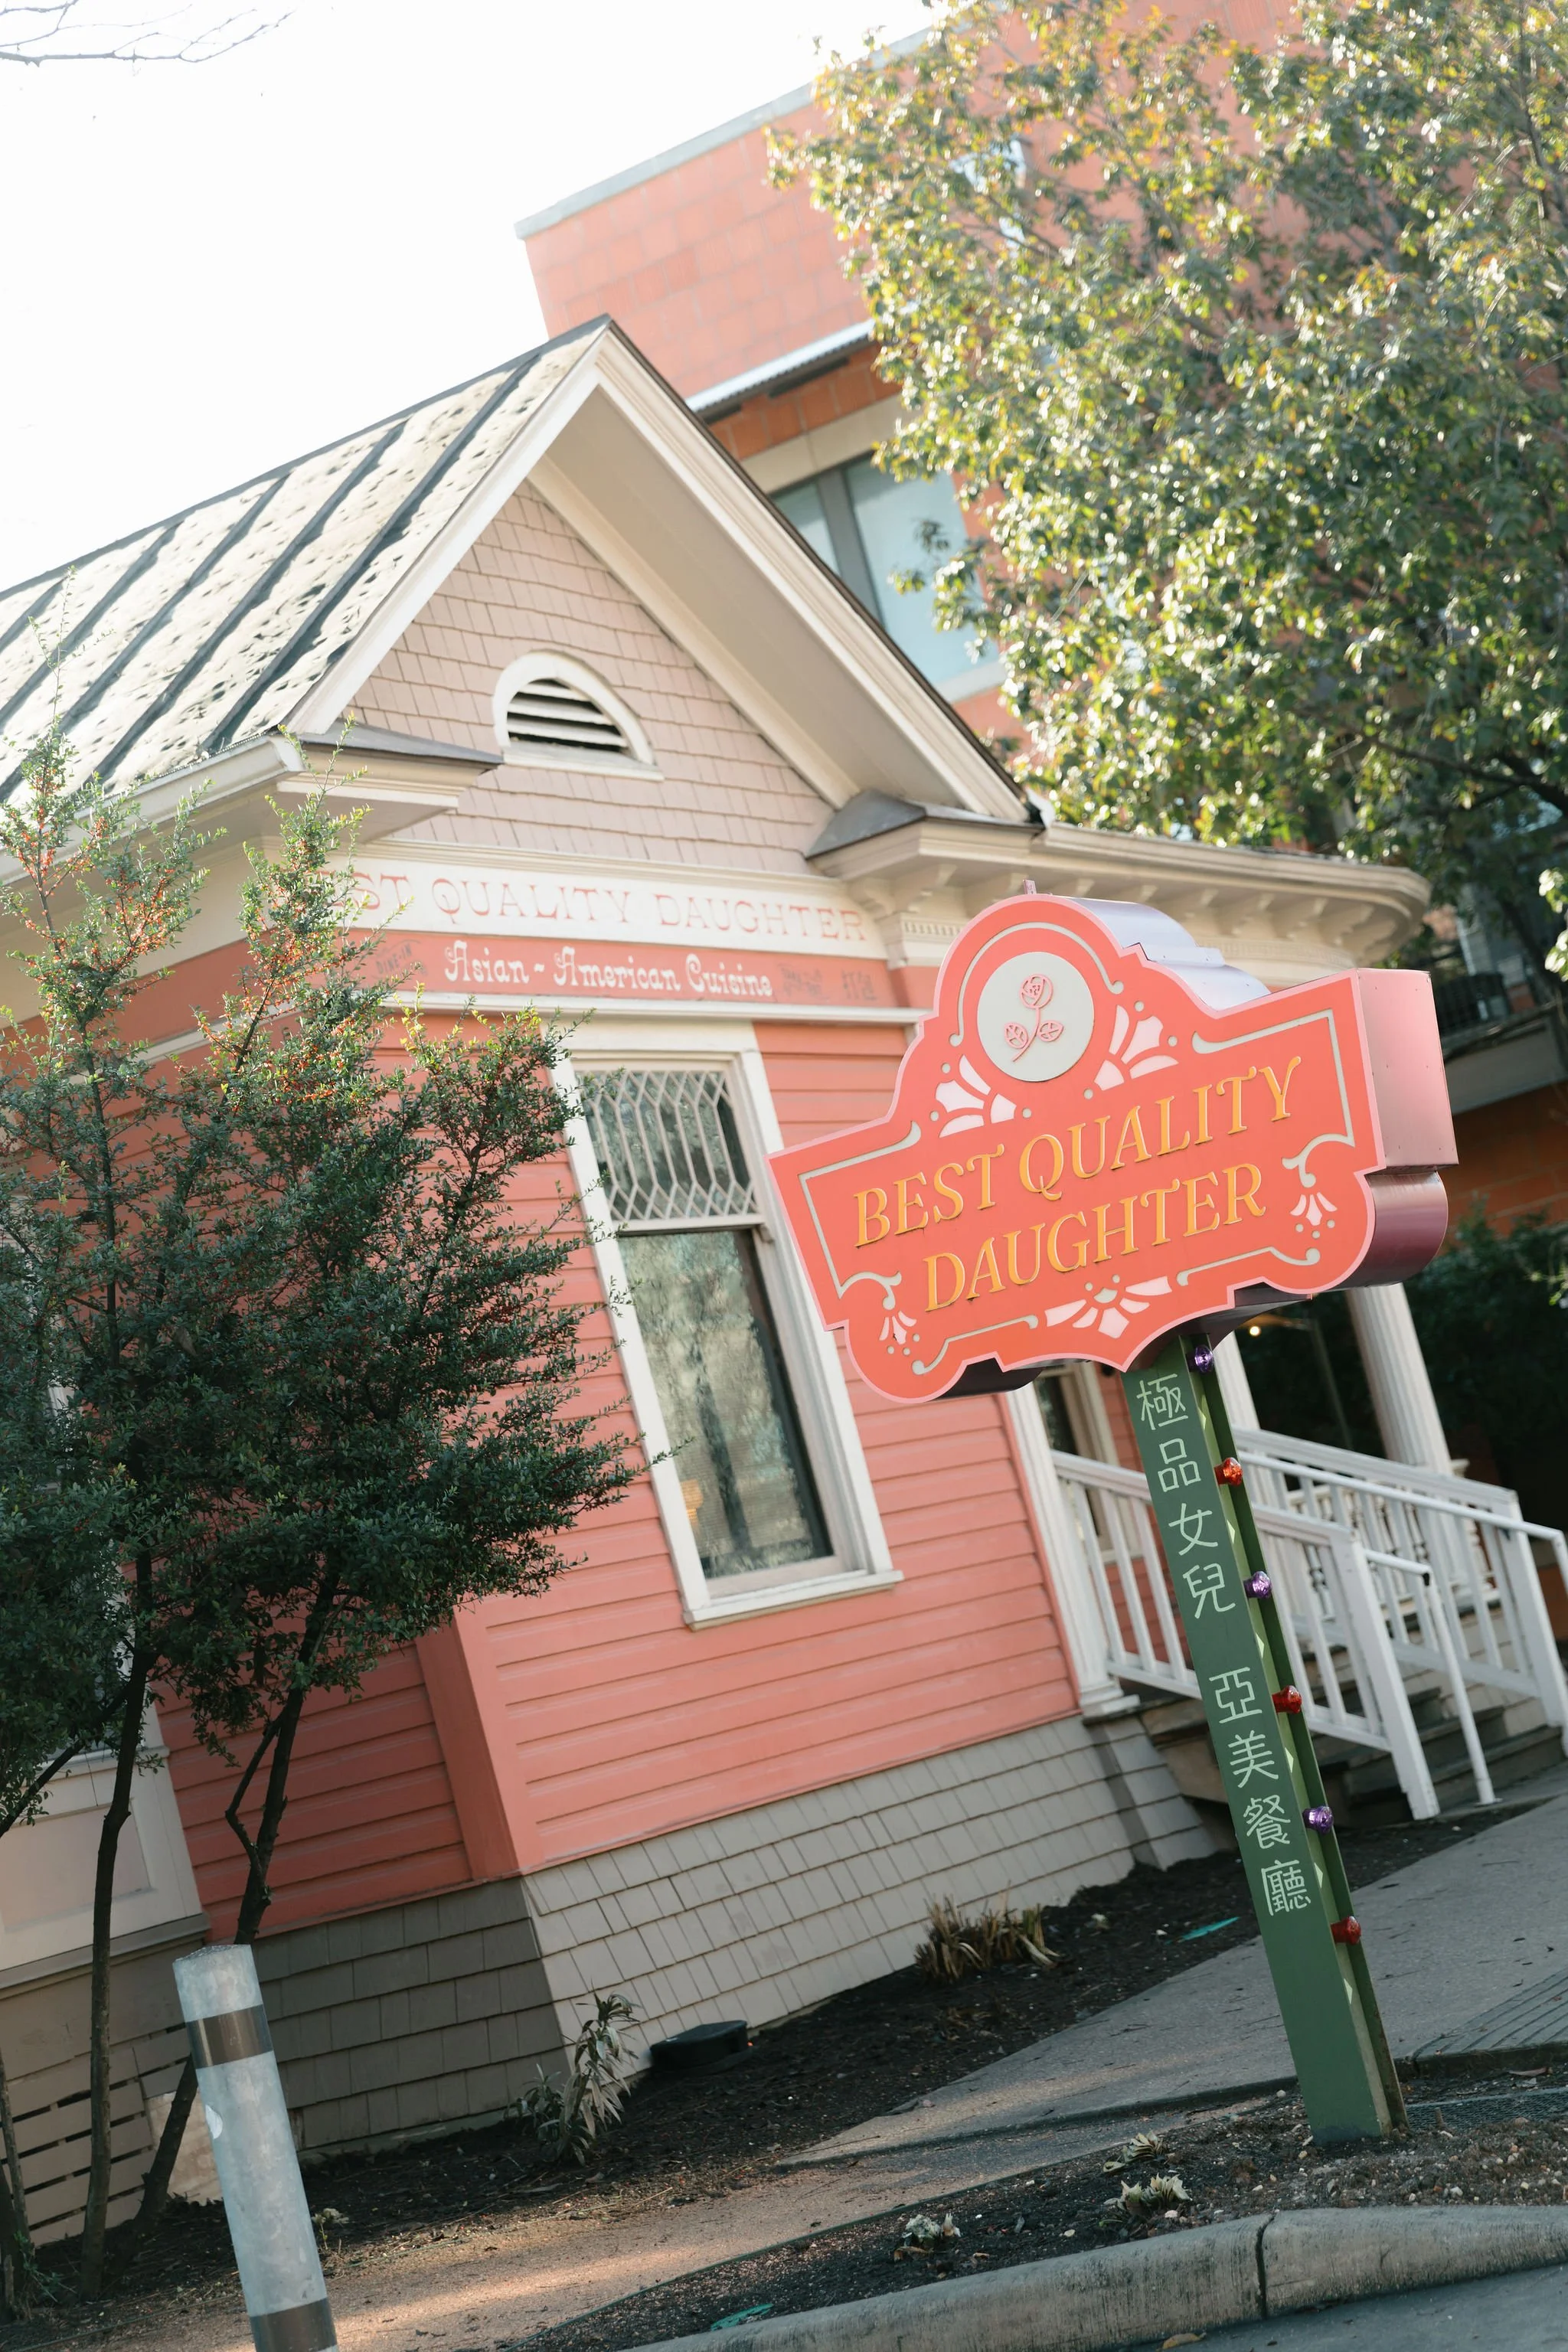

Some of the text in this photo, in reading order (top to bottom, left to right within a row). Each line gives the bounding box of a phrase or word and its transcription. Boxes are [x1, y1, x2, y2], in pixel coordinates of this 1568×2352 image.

[431, 877, 630, 925] QUALITY
[653, 893, 867, 941] DAUGHTER
[444, 939, 529, 984] Asian
[554, 945, 681, 991] American
[685, 952, 773, 996] Cuisine
[854, 1056, 1302, 1248] BEST QUALITY
[922, 1162, 1266, 1312] DAUGHTER
[1137, 1373, 1312, 1917] 極品女兒 亞美餐廳
